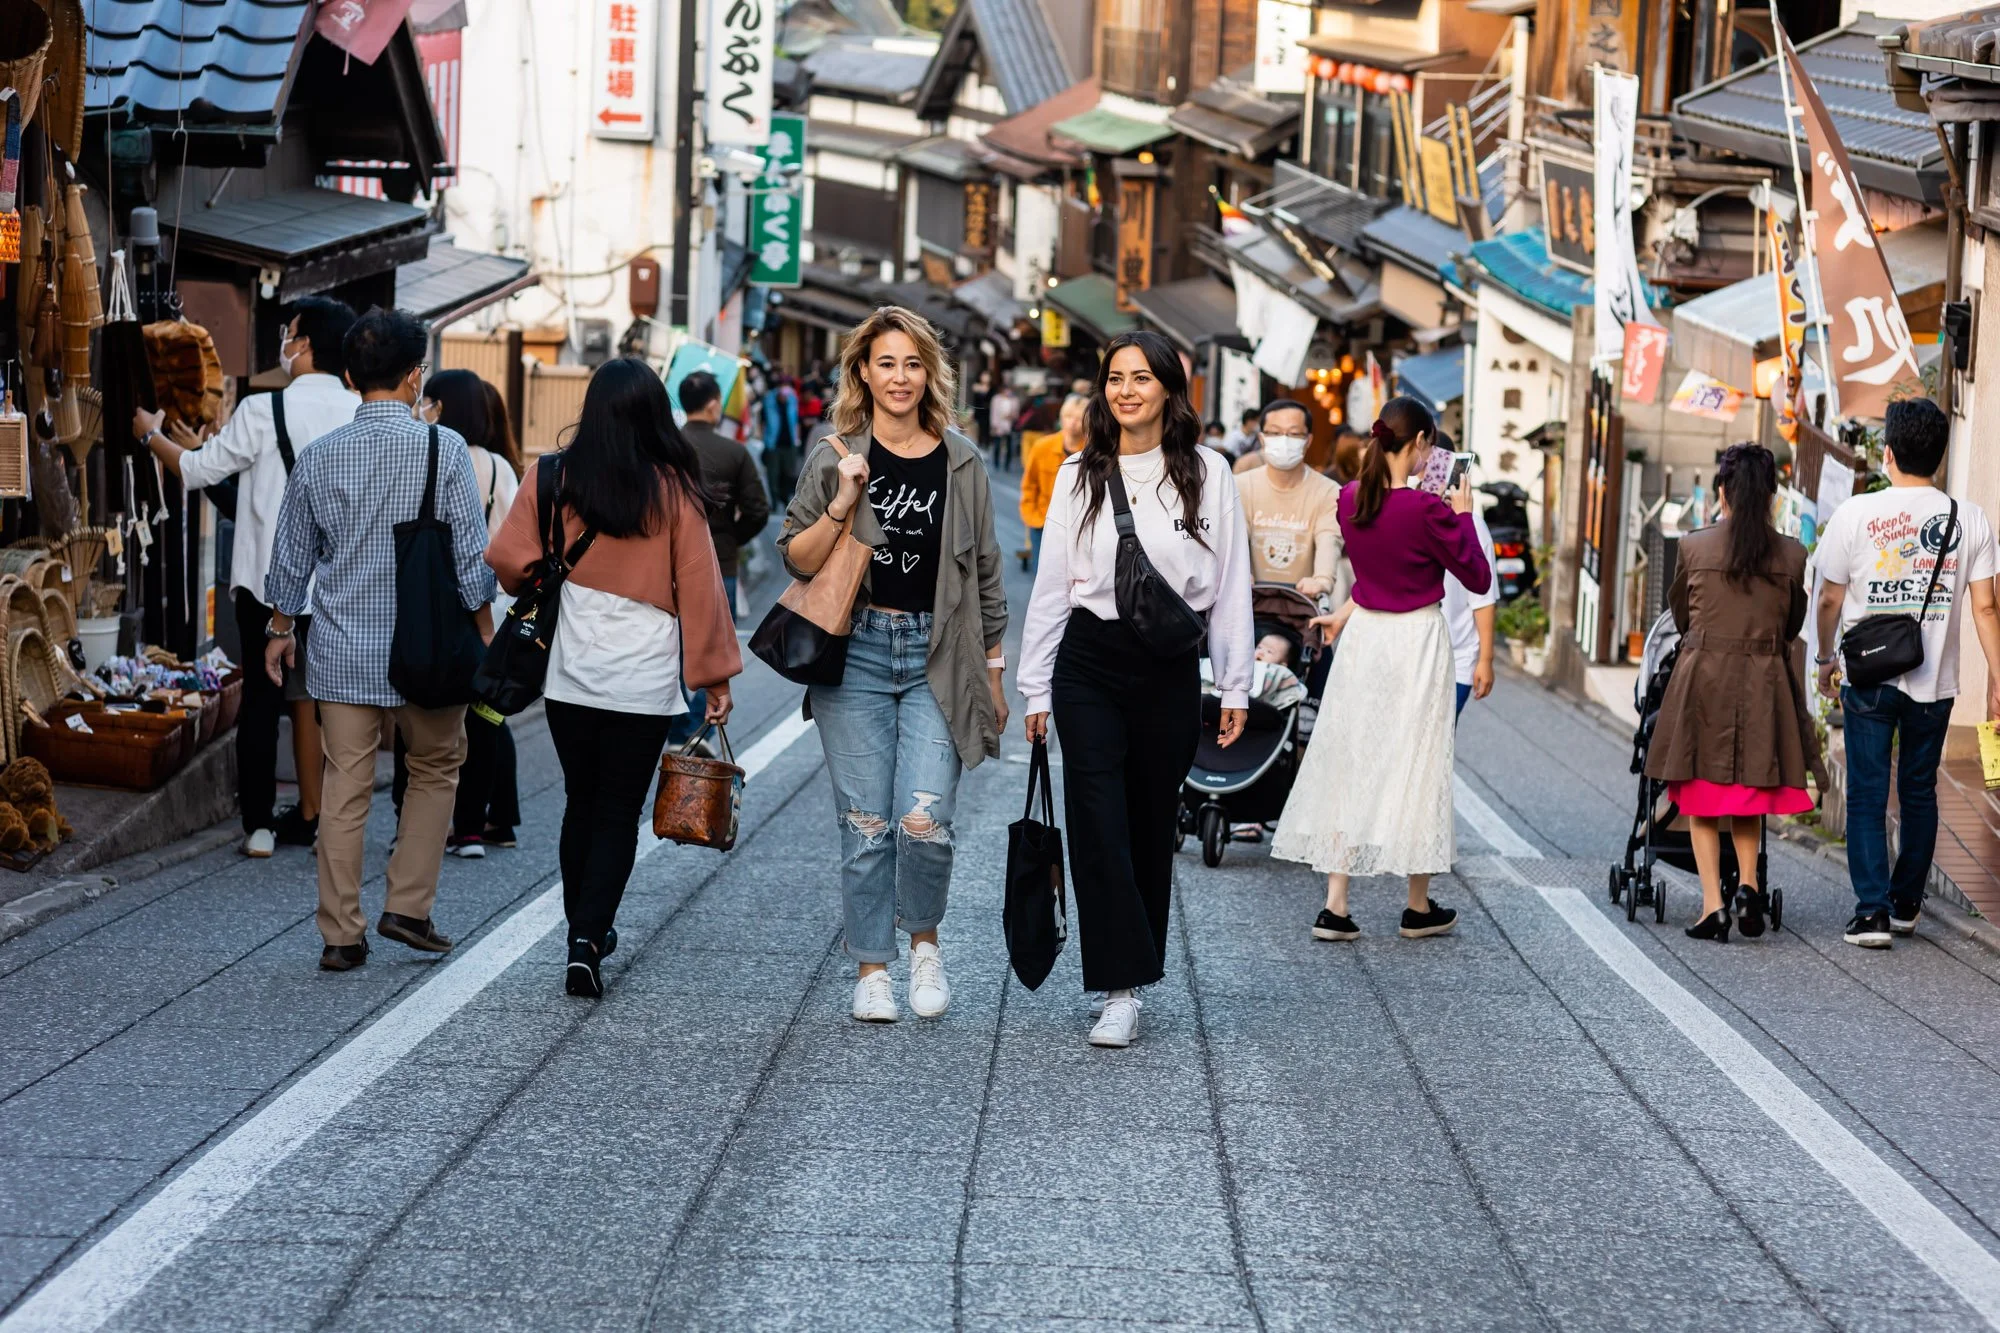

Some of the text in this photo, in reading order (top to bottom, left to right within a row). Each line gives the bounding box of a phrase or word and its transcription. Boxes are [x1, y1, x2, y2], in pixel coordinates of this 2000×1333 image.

[607, 4, 638, 98] 駐車場
[1867, 511, 1911, 538] Keep On
[1883, 525, 1919, 541] Surfing
[1868, 579, 1914, 594] T&C
[1868, 593, 1952, 605] Surf Desgns
